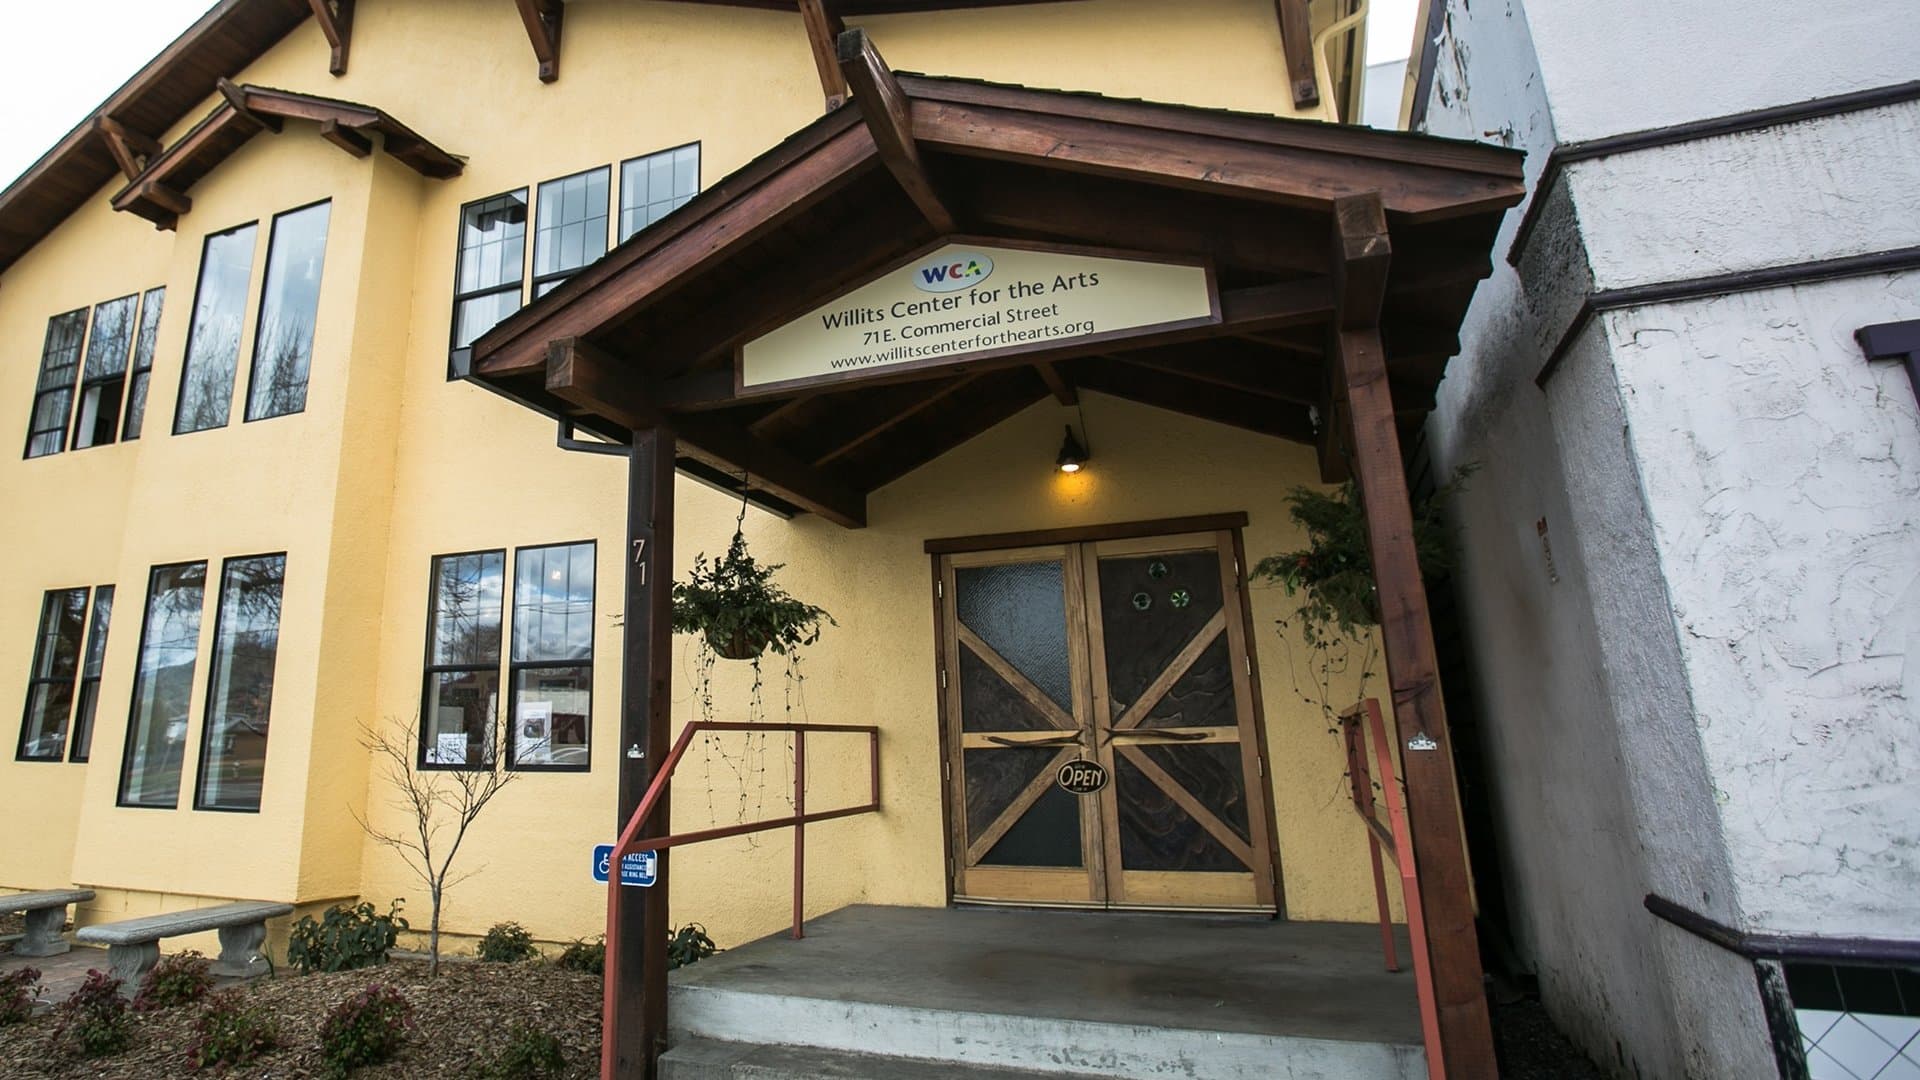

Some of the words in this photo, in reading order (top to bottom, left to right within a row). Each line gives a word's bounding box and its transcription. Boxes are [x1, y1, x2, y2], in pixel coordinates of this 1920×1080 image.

[921, 260, 981, 284] WCA
[822, 308, 885, 330] Willits
[890, 295, 962, 318] Center
[969, 288, 1001, 306] for
[1008, 281, 1044, 299] the
[1051, 272, 1099, 293] Arts
[830, 320, 1095, 369] www.willitscenterforthearts.org
[863, 331, 879, 345] 71
[883, 329, 897, 342] E.
[900, 311, 1001, 339] Commercial
[1006, 303, 1059, 323] Street
[633, 539, 646, 585] 71
[1060, 765, 1102, 786] OPEN
